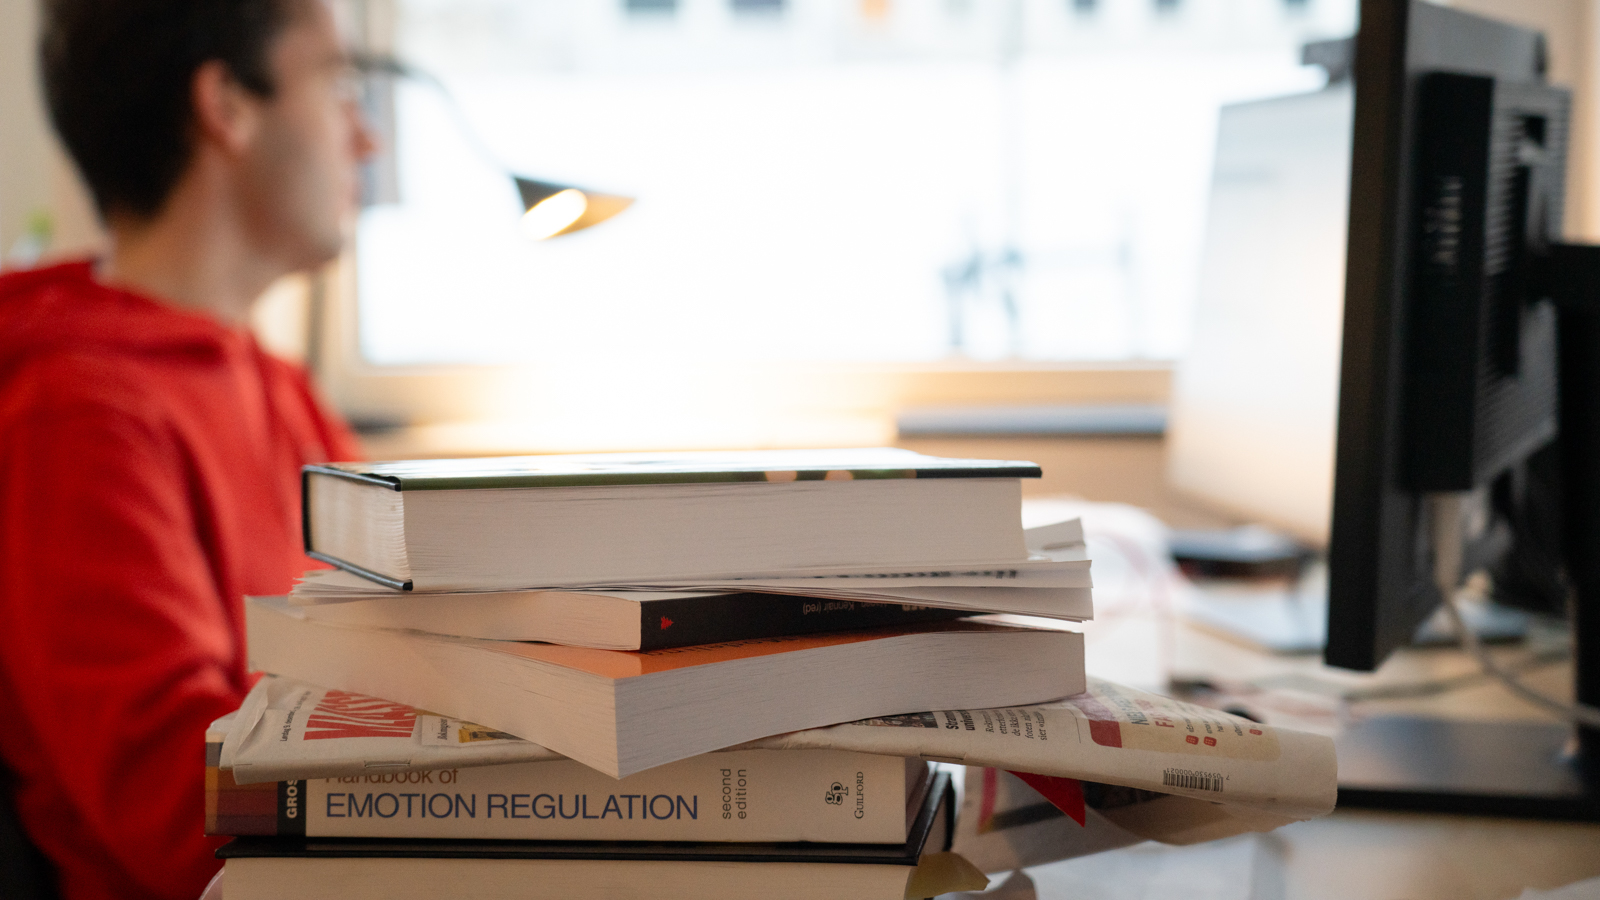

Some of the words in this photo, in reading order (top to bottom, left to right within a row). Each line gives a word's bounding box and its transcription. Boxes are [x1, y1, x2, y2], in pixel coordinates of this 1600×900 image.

[803, 602, 822, 616] (red)
[439, 768, 459, 784] of
[326, 792, 476, 819] EMOTION
[487, 794, 698, 821] REGULATION
[720, 768, 732, 820] second
[735, 769, 747, 820] edition
